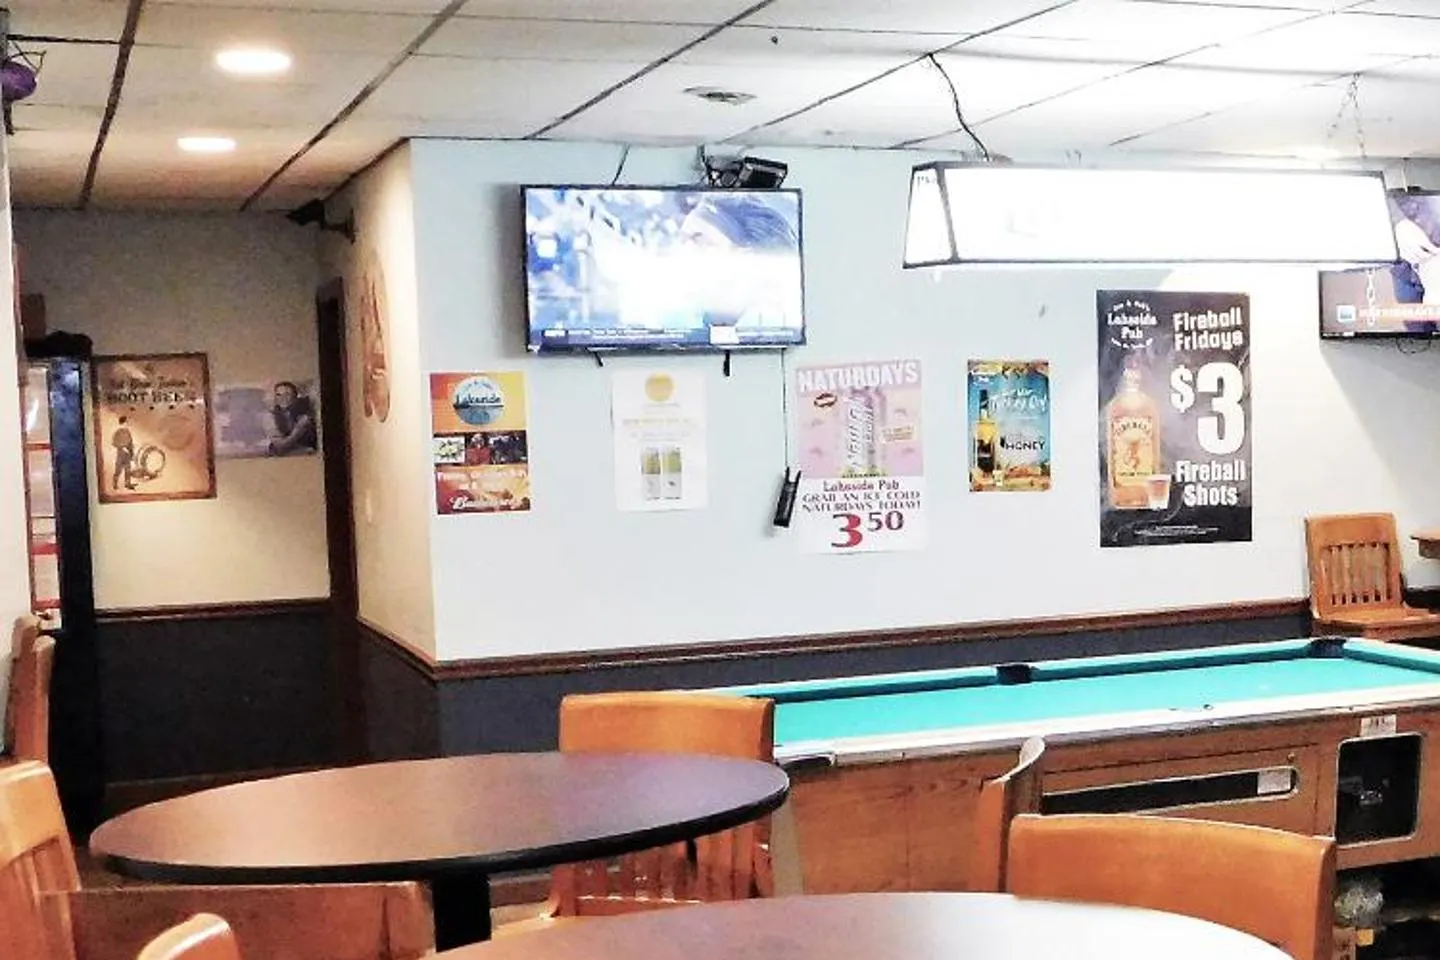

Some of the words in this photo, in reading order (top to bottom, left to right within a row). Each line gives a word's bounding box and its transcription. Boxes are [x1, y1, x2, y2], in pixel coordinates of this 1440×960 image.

[1173, 307, 1242, 331] Fireball
[1121, 326, 1143, 339] Pub
[1175, 329, 1243, 351] Fridays
[799, 361, 919, 392] NATURDAYS
[1170, 361, 1246, 455] $3
[1175, 460, 1246, 483] Fireball
[878, 479, 900, 490] Pub
[1183, 484, 1239, 507] Shots
